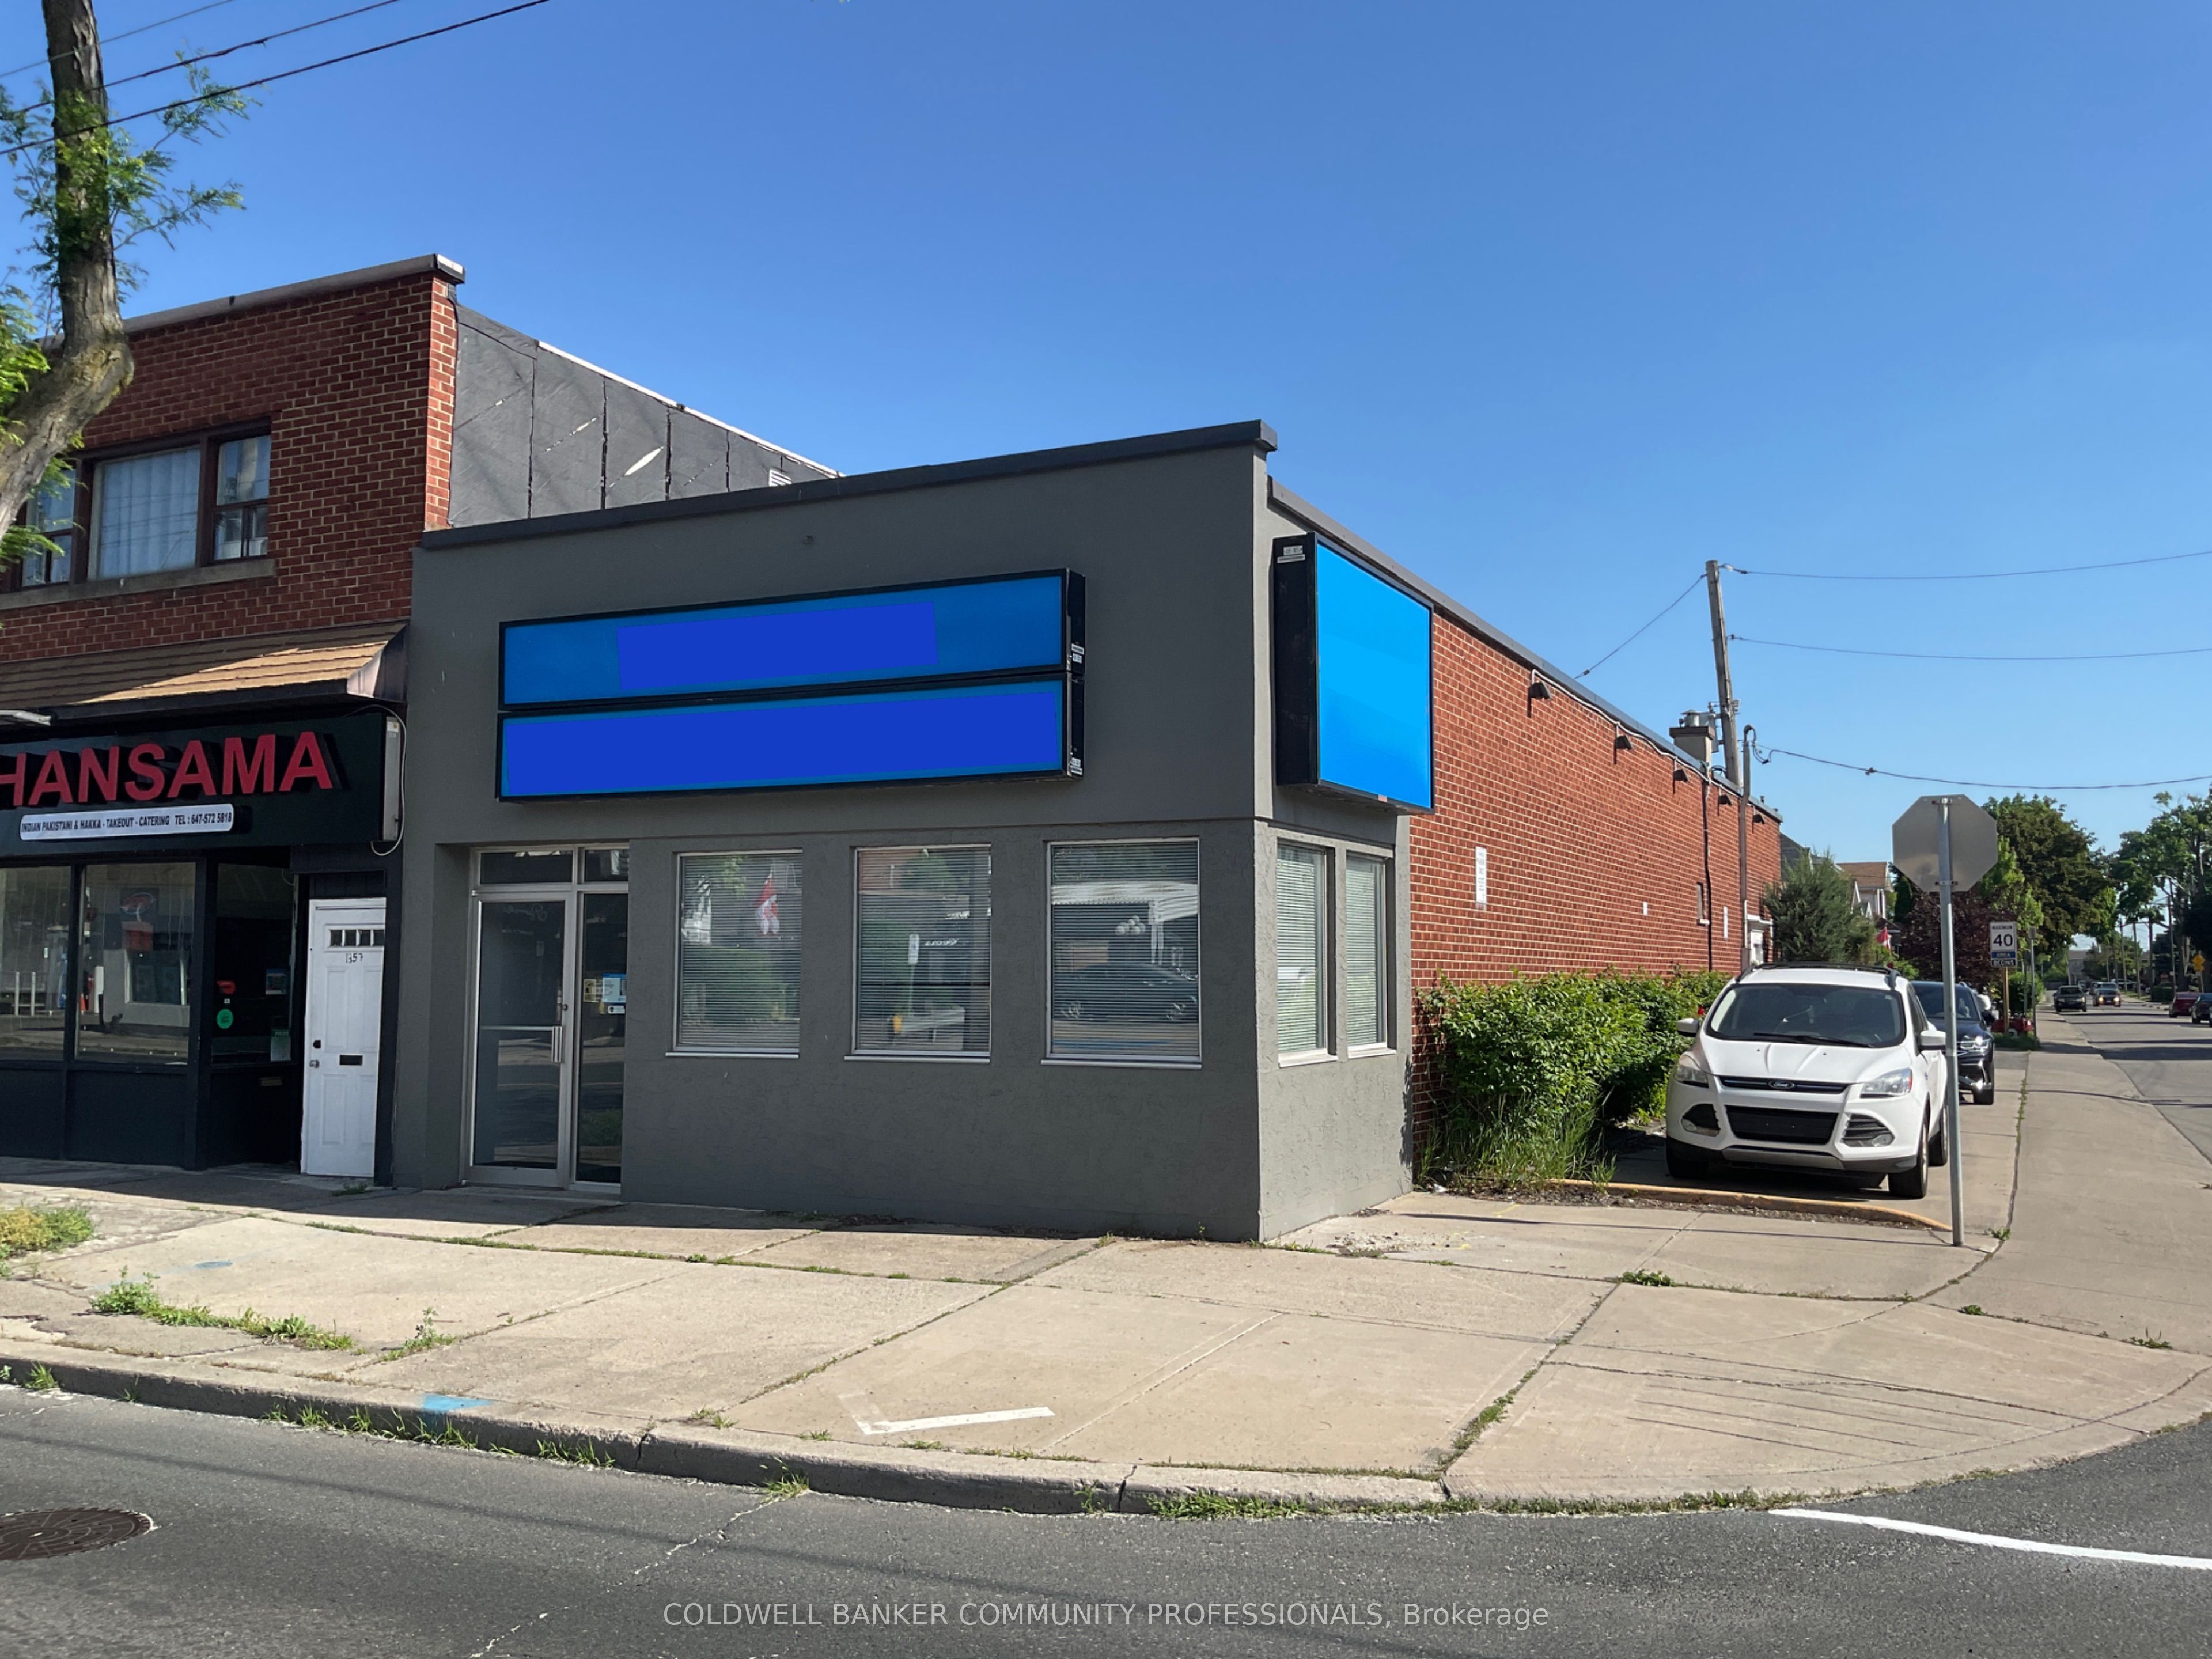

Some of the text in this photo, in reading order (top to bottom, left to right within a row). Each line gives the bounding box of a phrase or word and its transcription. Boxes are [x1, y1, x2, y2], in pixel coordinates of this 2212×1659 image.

[21, 822, 41, 832] INDIAN
[42, 820, 73, 831] PAKISTANI
[74, 820, 78, 830] &
[81, 819, 101, 830] HAKKA
[106, 817, 134, 829] TAKEOUT
[139, 816, 169, 827] CATERING
[191, 813, 215, 824] 647-572
[1993, 934, 2013, 946] 40
